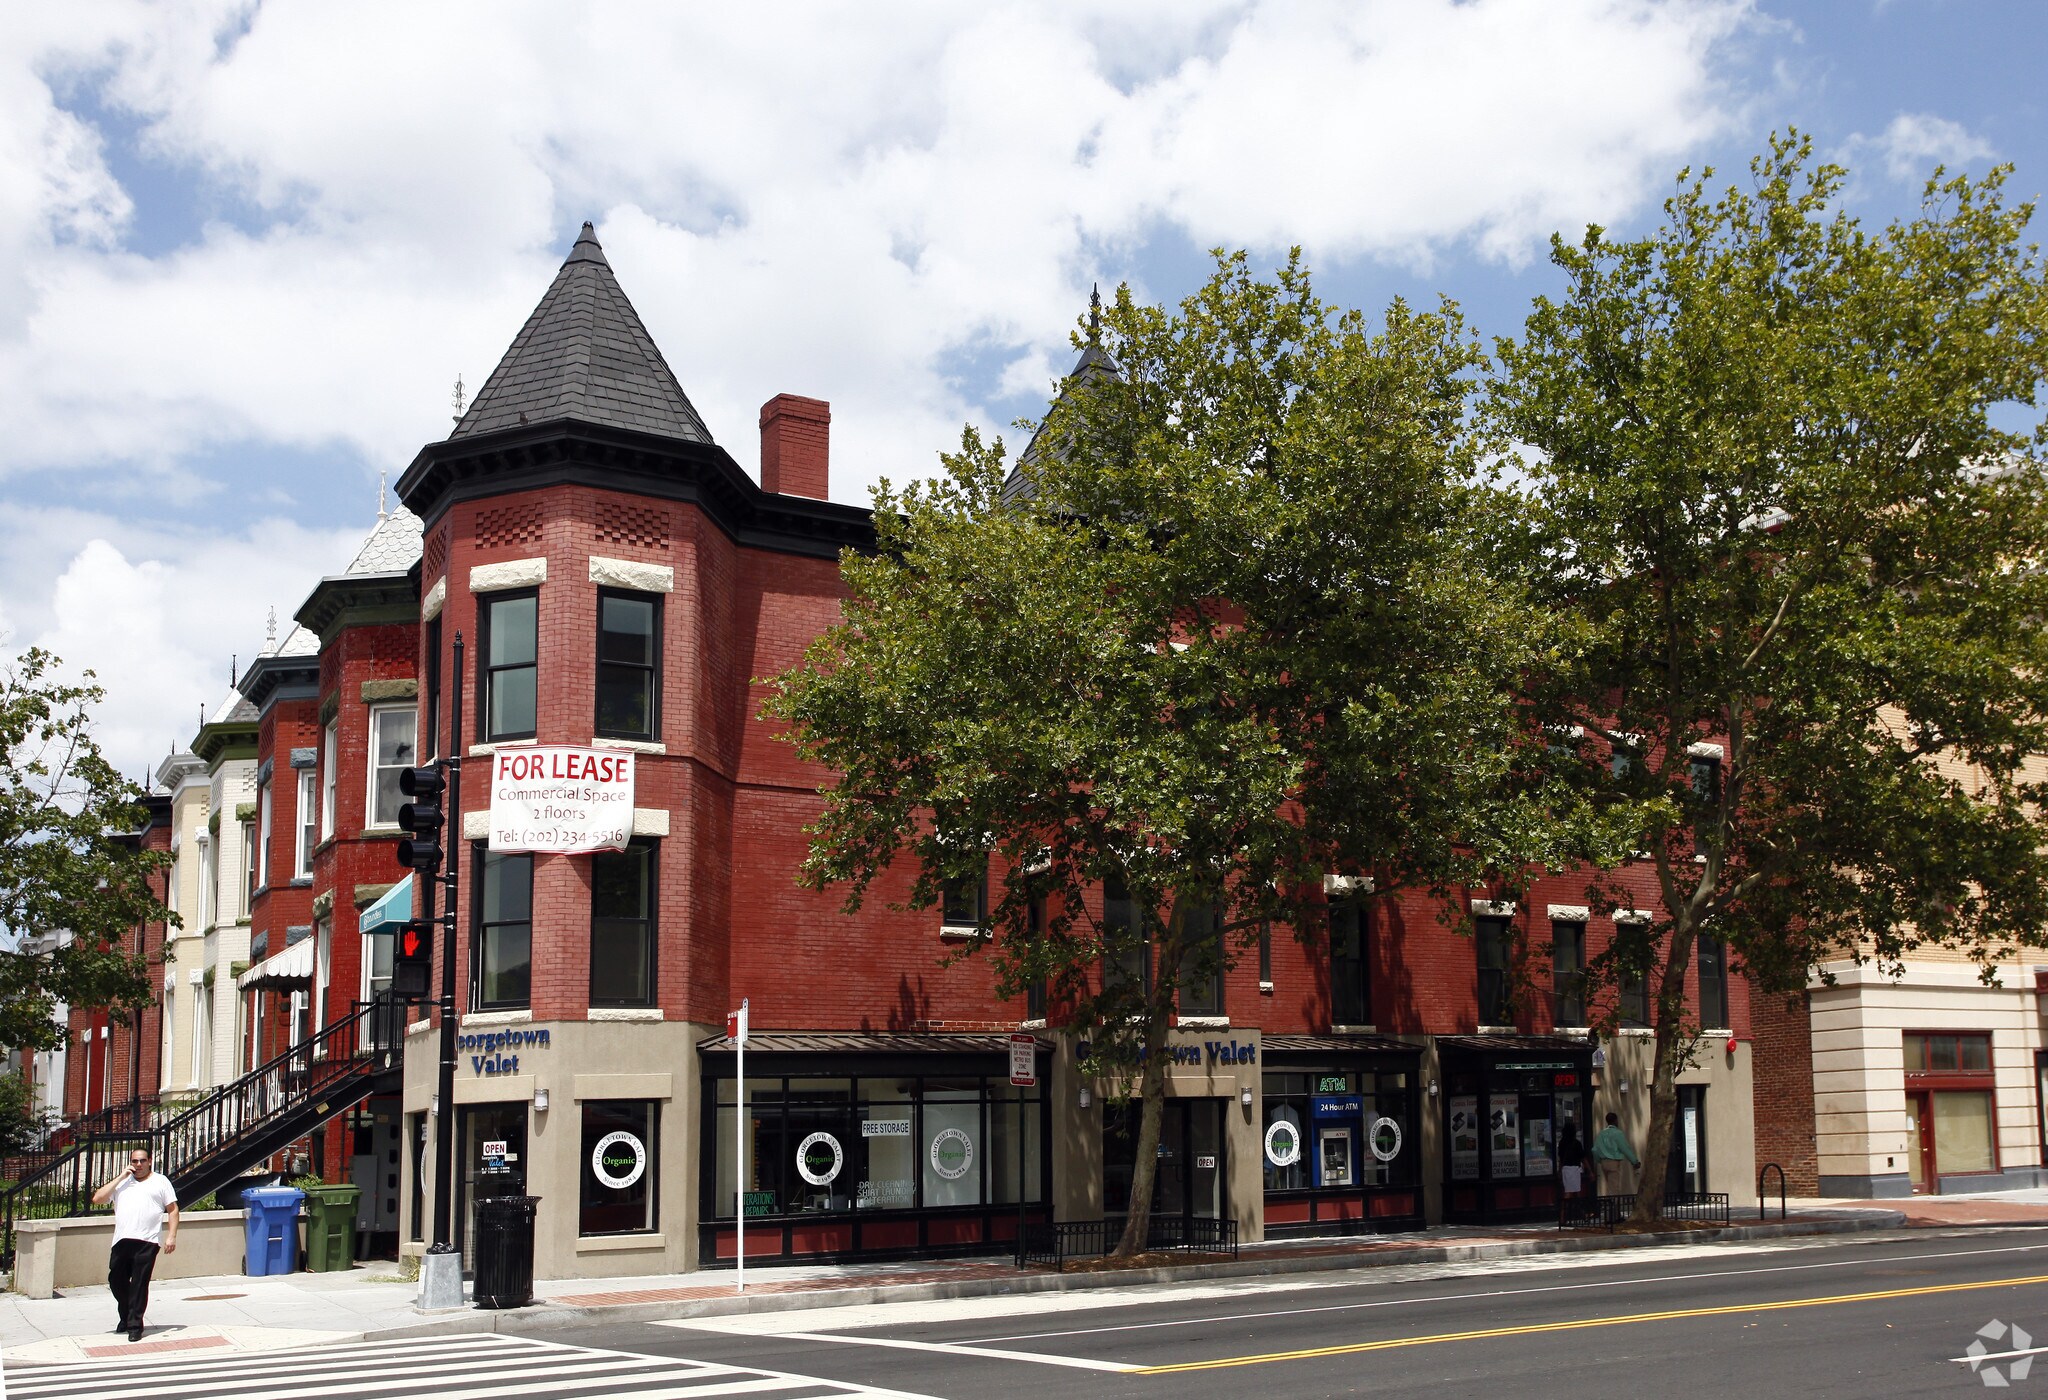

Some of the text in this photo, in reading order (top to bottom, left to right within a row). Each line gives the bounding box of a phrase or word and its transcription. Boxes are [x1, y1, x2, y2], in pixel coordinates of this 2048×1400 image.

[499, 753, 629, 783] FOR LEASE
[498, 787, 626, 804] Commercial Space
[533, 805, 586, 820] 2 floors
[497, 828, 623, 845] Tel: (202) 234-5516
[458, 1029, 550, 1052] eorgetown
[1205, 1040, 1256, 1063] Valet
[472, 1053, 519, 1074] Valet
[1320, 1077, 1346, 1092] ATM
[1554, 1074, 1576, 1087] OPEN
[1320, 1102, 1359, 1111] 24 Hour ATM
[862, 1122, 909, 1134] FREE STORAGE
[485, 1144, 505, 1154] OPEN
[595, 1134, 642, 1165] GEORGETOWN VALET
[799, 1134, 832, 1164] GEORGETOWN
[933, 1130, 963, 1159] GEORGETOWN
[1272, 1140, 1293, 1150] Organic
[602, 1156, 636, 1168] Organic
[805, 1155, 834, 1166] Organic
[1199, 1158, 1214, 1167] OPEN
[603, 1175, 637, 1187] Since 1984
[806, 1173, 821, 1183] Since
[743, 1193, 774, 1205] TERATIONS
